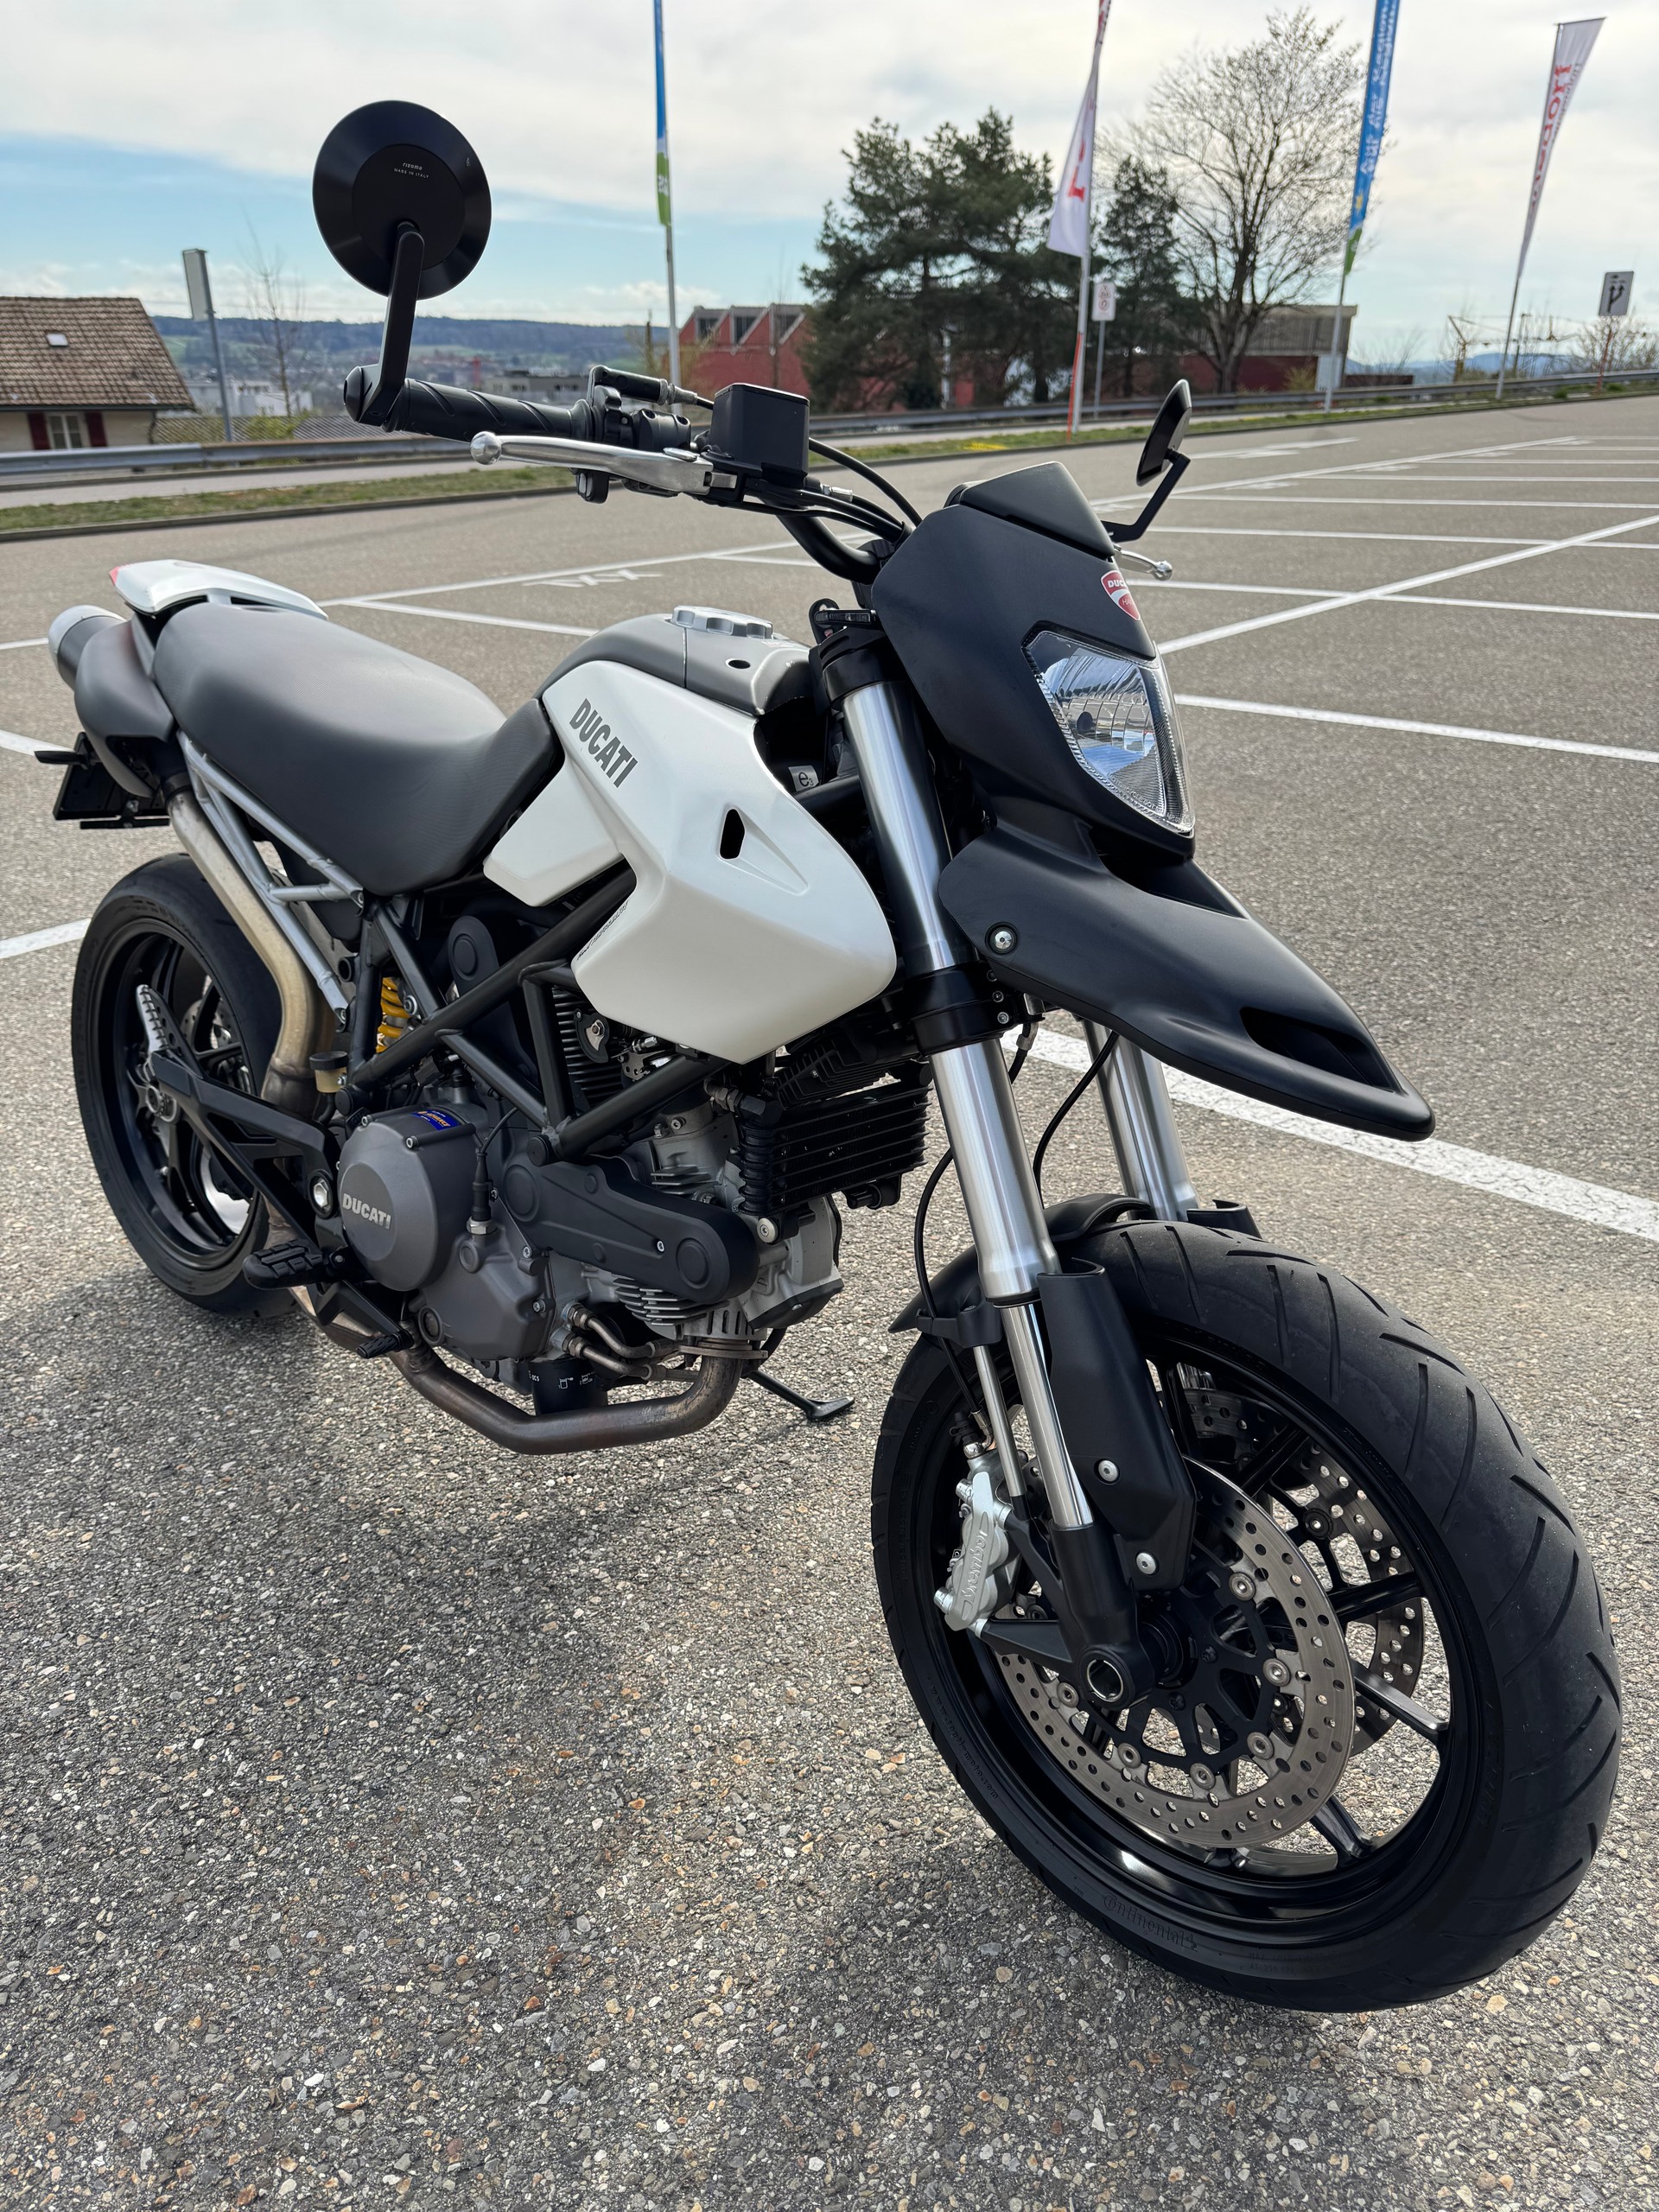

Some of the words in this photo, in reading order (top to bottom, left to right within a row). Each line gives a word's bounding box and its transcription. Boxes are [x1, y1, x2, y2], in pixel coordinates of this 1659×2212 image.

[403, 162, 423, 171] rizoma
[1107, 579, 1127, 588] DUC
[569, 697, 639, 789] DUCATI
[342, 1193, 391, 1230] DUCATI
[961, 1534, 988, 1600] brembo
[1103, 1891, 1185, 1947] Continental
